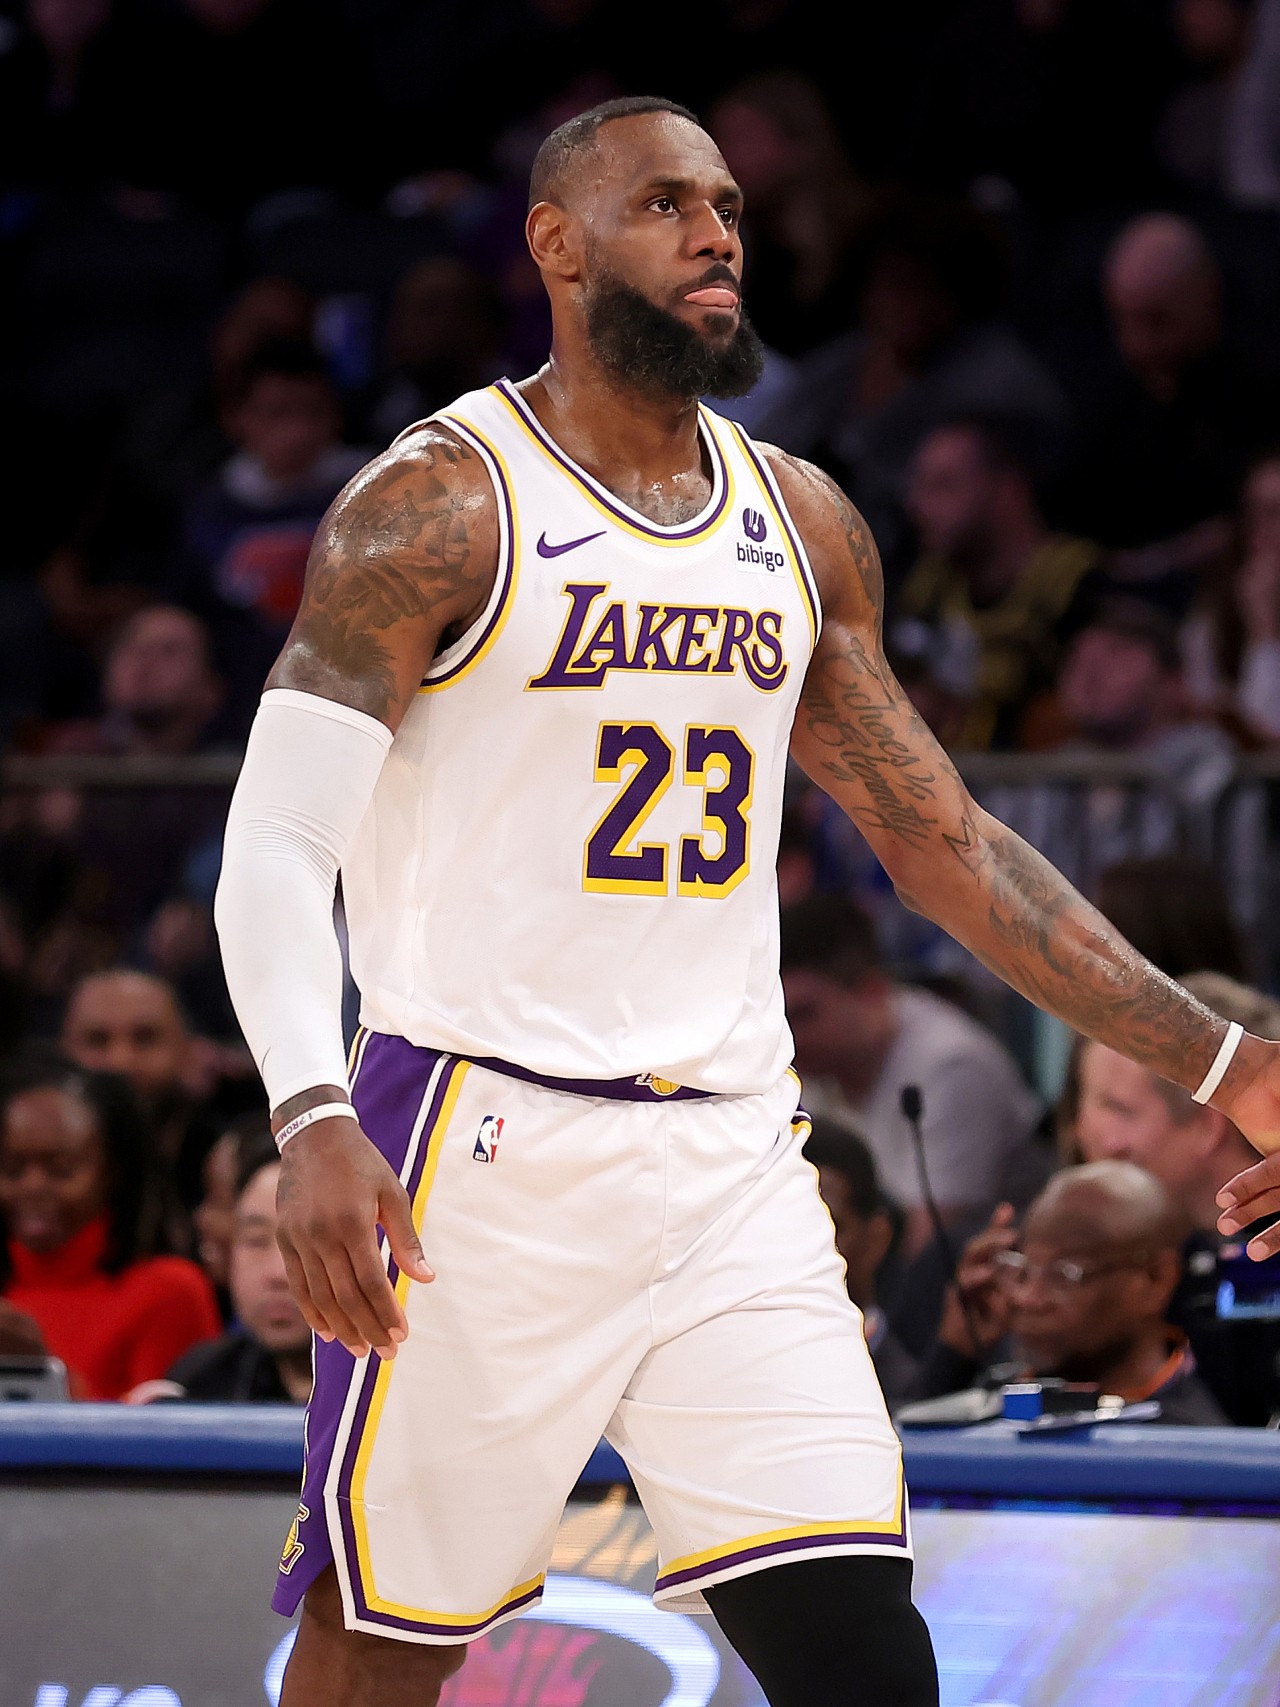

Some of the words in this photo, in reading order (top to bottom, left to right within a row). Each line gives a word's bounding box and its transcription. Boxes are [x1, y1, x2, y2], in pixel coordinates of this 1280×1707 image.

[736, 542, 784, 572] bibigo
[523, 581, 789, 694] LAKERS
[582, 720, 756, 899] 23
